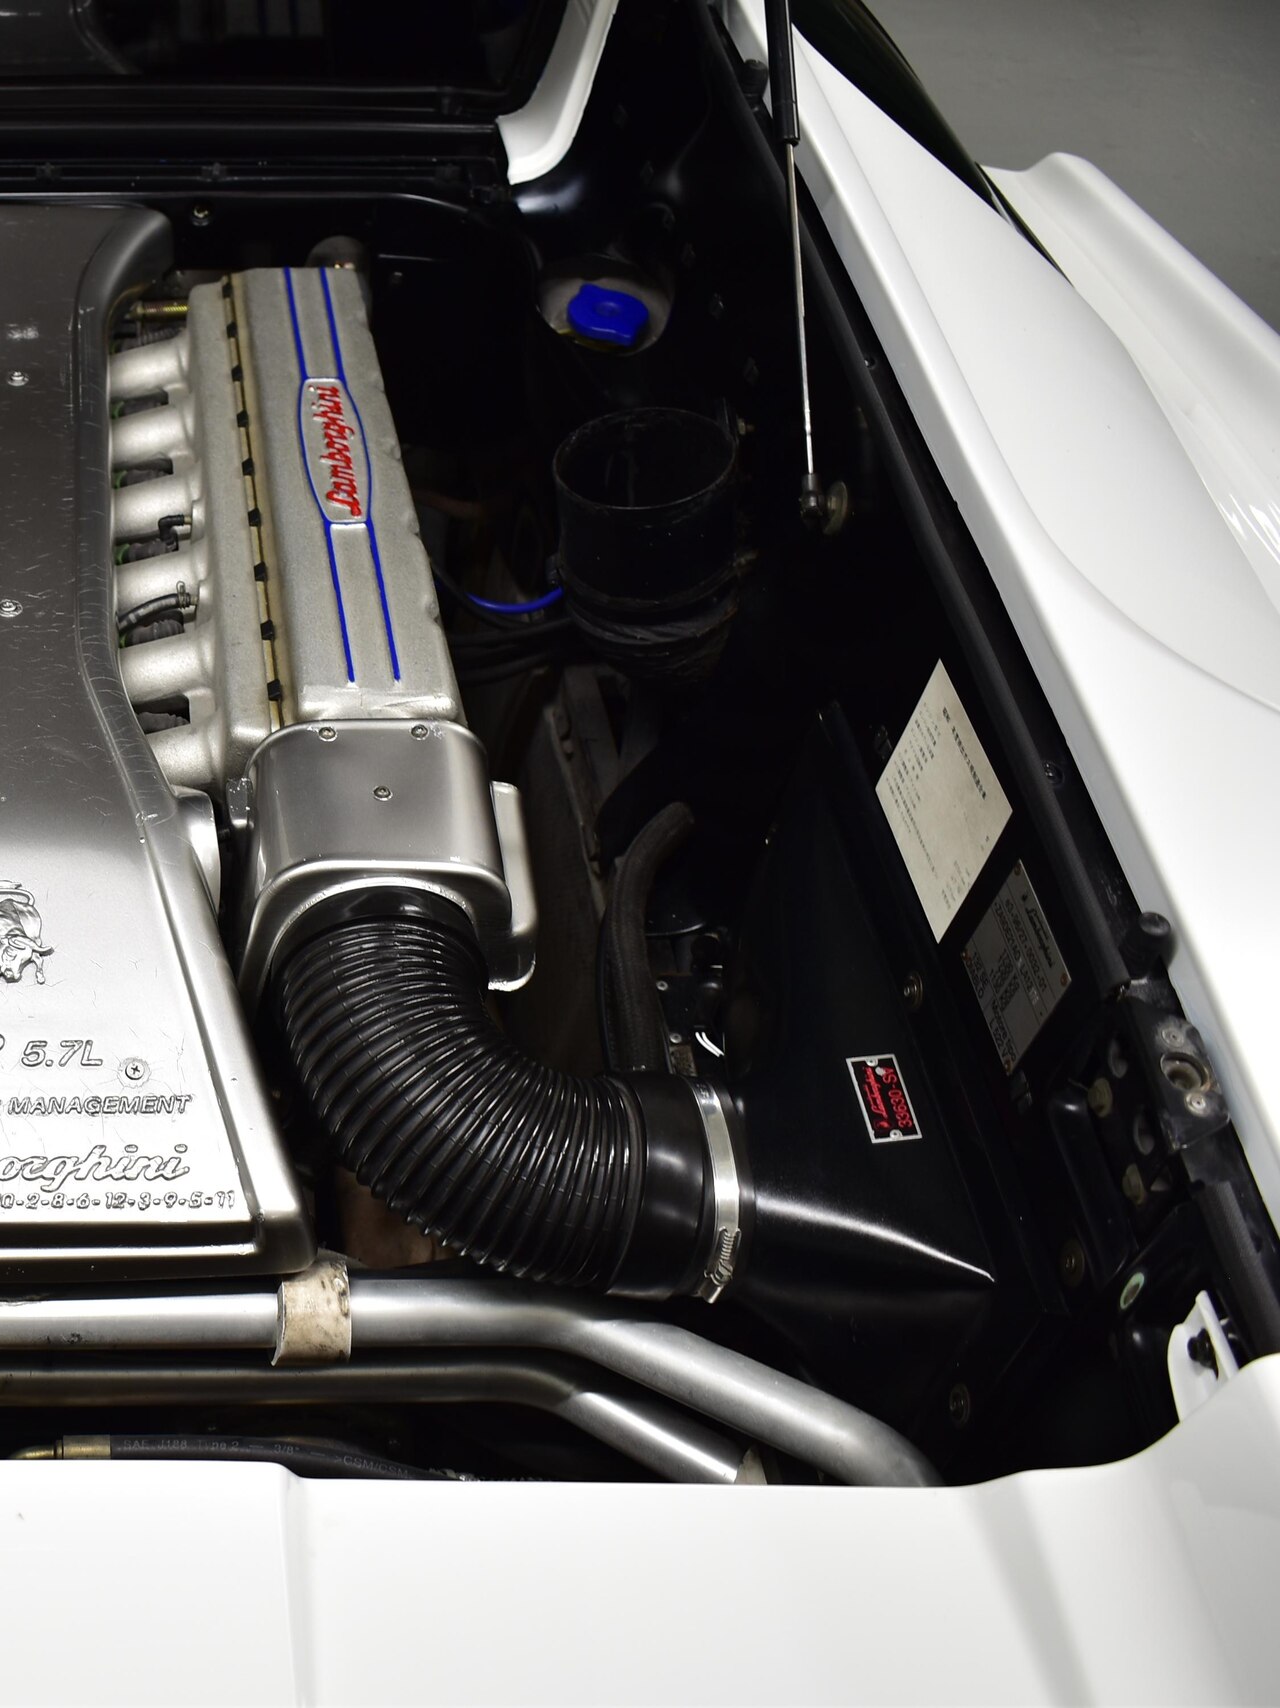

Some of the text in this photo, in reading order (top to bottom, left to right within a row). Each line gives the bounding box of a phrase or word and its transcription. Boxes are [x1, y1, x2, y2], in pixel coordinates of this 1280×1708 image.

[307, 385, 362, 518] Lamborghini
[21, 1039, 103, 1067] 5.7L
[7, 1095, 192, 1116] MANAGEMENT
